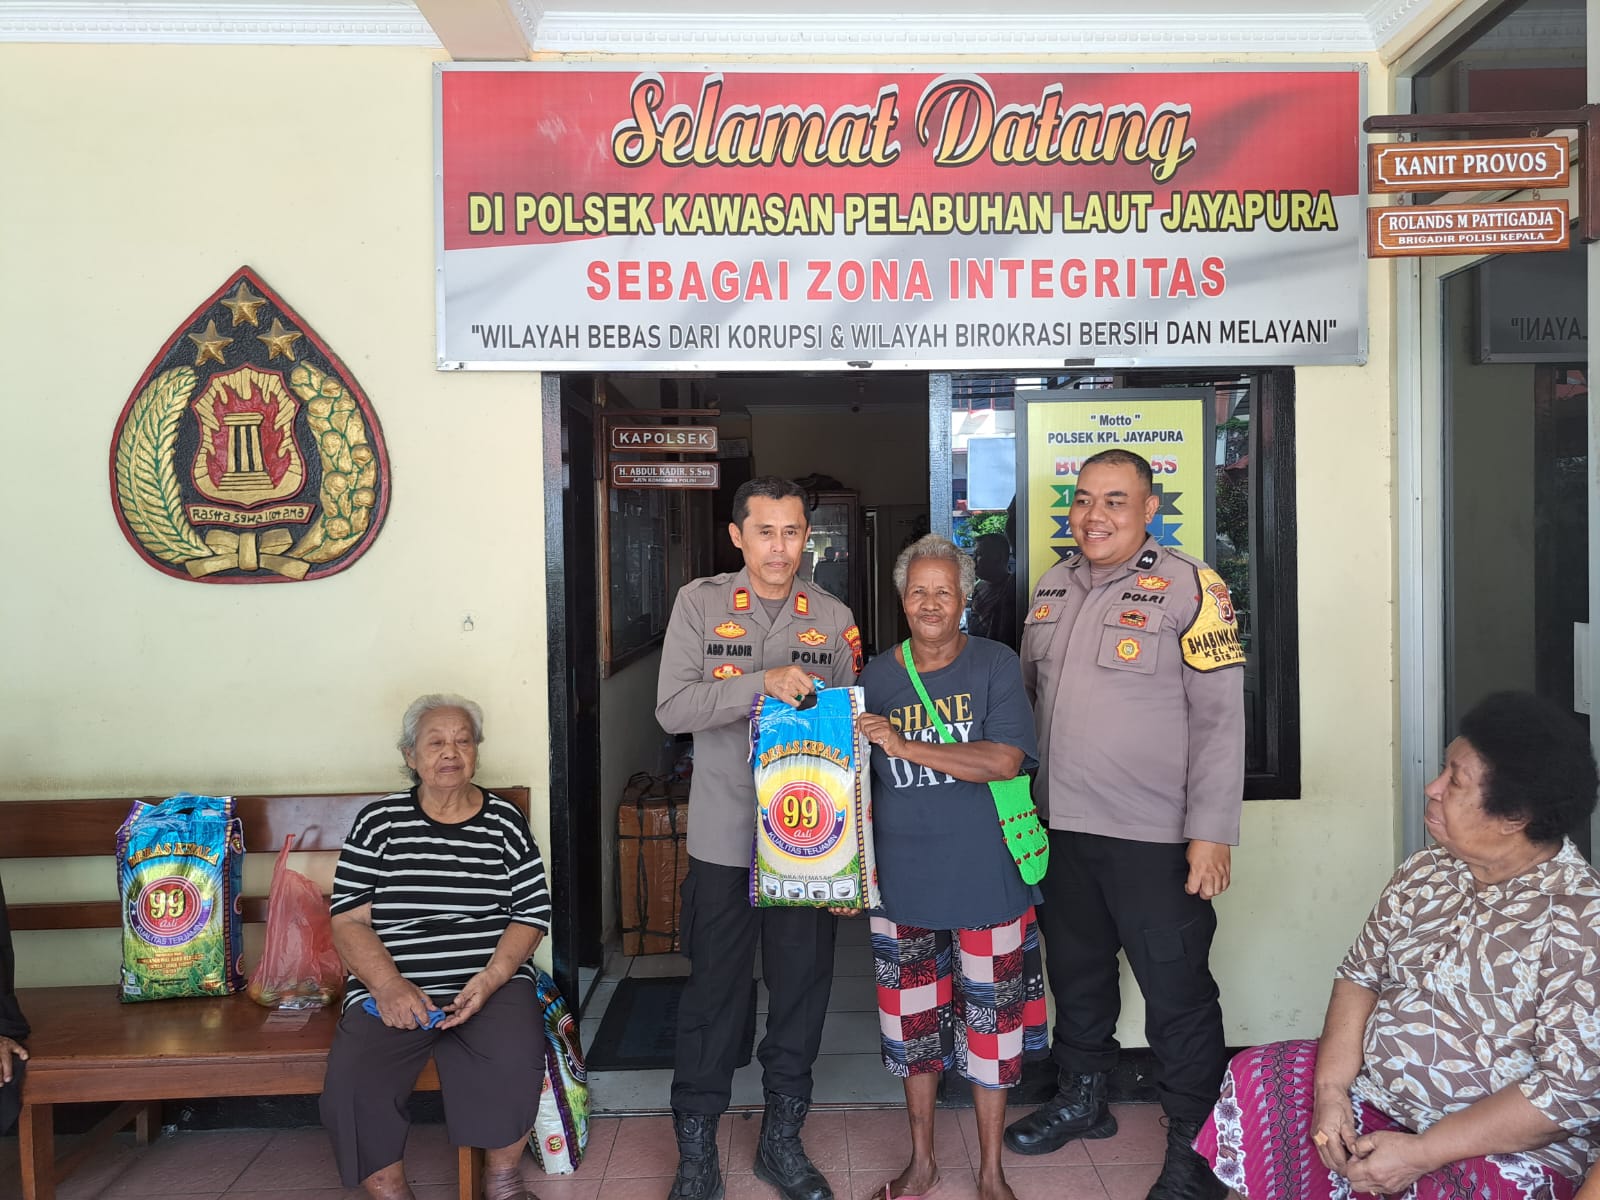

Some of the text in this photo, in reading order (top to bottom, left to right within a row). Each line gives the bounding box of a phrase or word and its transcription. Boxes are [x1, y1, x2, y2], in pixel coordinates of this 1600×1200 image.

[611, 72, 1196, 183] Selamat Datang
[1394, 152, 1548, 176] KANIT PROVOS
[467, 190, 1338, 235] DI POLSEK KAWASAN PELABUHAN LAUT JAYAPURA
[1389, 212, 1554, 231] ROLANDS M PATTIGADJA
[1398, 232, 1545, 245] BRIGADIR POLISI KEPALA
[586, 256, 1226, 301] SEBAGAI ZONA INTEGRITAS
[471, 319, 1337, 349] "WILAYAH BEBAS DARI KORUPSI & WILAYAH BIROKRASI BERSIH DAN MELAYANI"
[620, 432, 708, 444] KAPOLSEK
[1048, 430, 1183, 444] POLSEK KPL JAYAPURA
[630, 467, 657, 476] ABDUL
[1121, 592, 1165, 605] POLRI
[706, 644, 752, 657] ABD KADIR
[791, 650, 832, 665] POLRI
[783, 795, 820, 829] 99
[768, 831, 838, 855] KUALITAS TERJAMIN
[150, 888, 186, 919] 99
[136, 922, 204, 946] KUALITAS TERJAMIN
